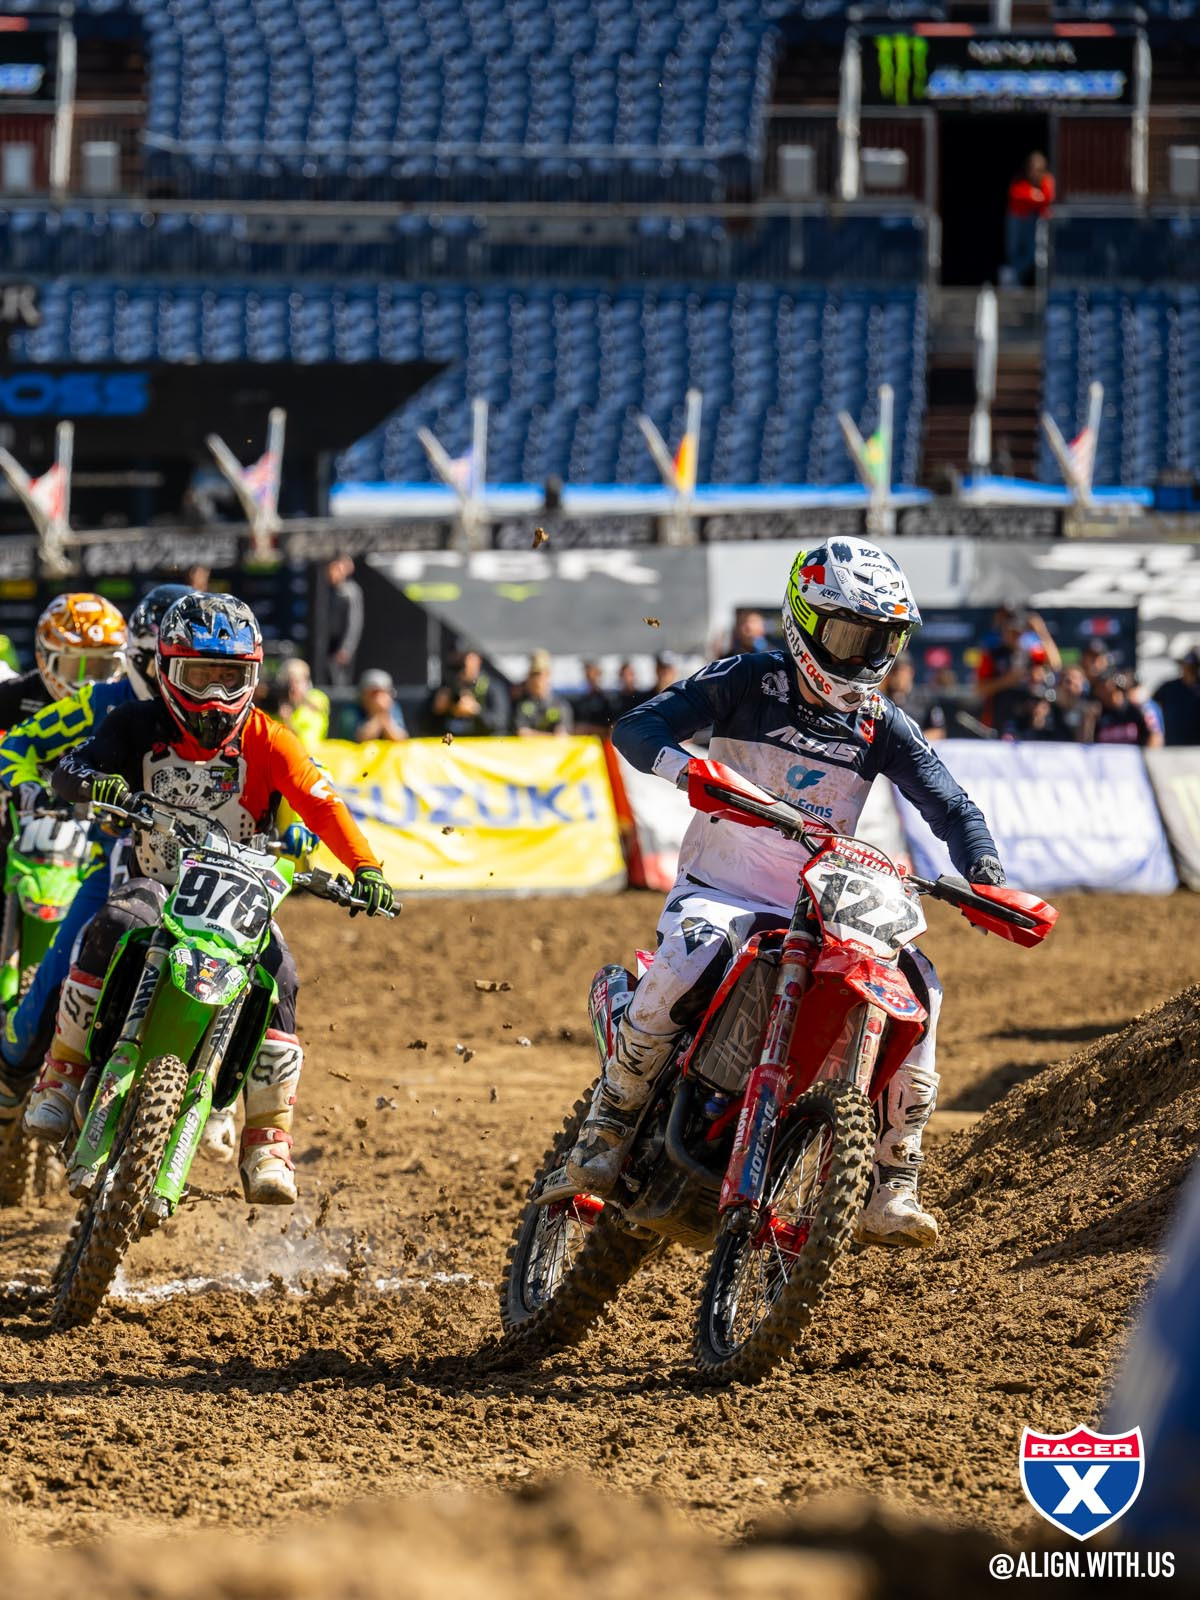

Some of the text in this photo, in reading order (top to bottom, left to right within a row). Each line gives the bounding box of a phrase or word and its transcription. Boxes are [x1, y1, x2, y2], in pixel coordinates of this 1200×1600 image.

[858, 548, 881, 560] 122
[785, 615, 833, 695] OnlyFans
[818, 872, 919, 950] 122
[165, 1107, 200, 1188] MAHONEY
[749, 1101, 777, 1187] DLOP
